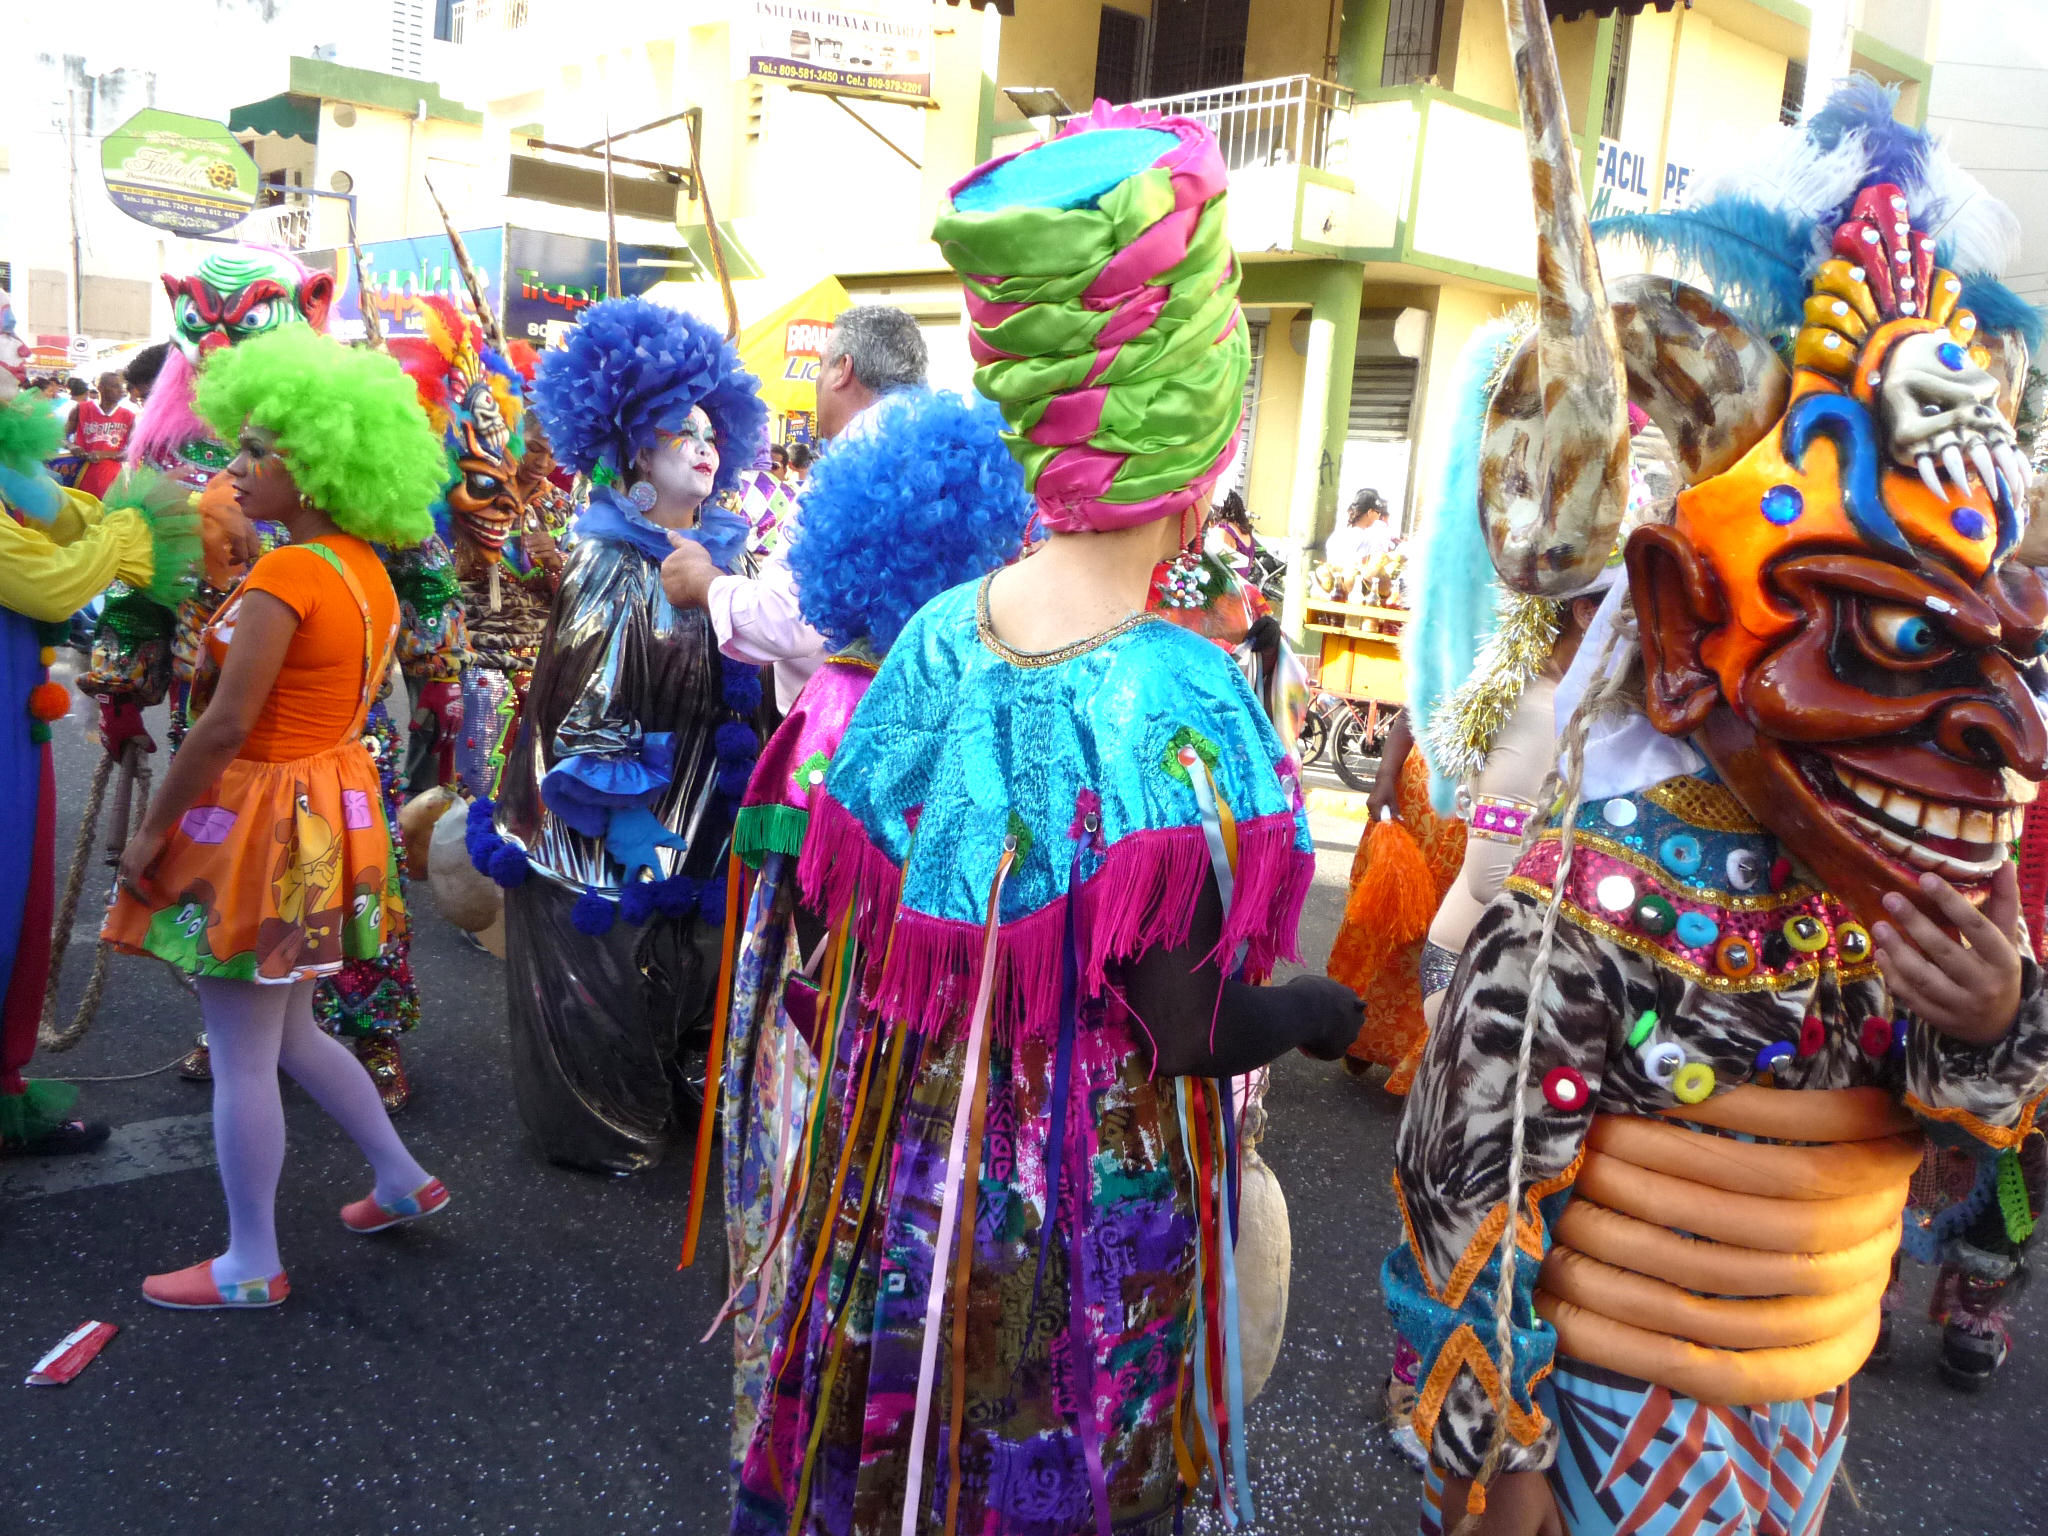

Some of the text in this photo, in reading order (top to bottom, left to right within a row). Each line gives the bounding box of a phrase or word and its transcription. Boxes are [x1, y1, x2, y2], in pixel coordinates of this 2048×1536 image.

[758, 61, 922, 94] Tel.: 809-581-3450 Cel.: 809-979-2201
